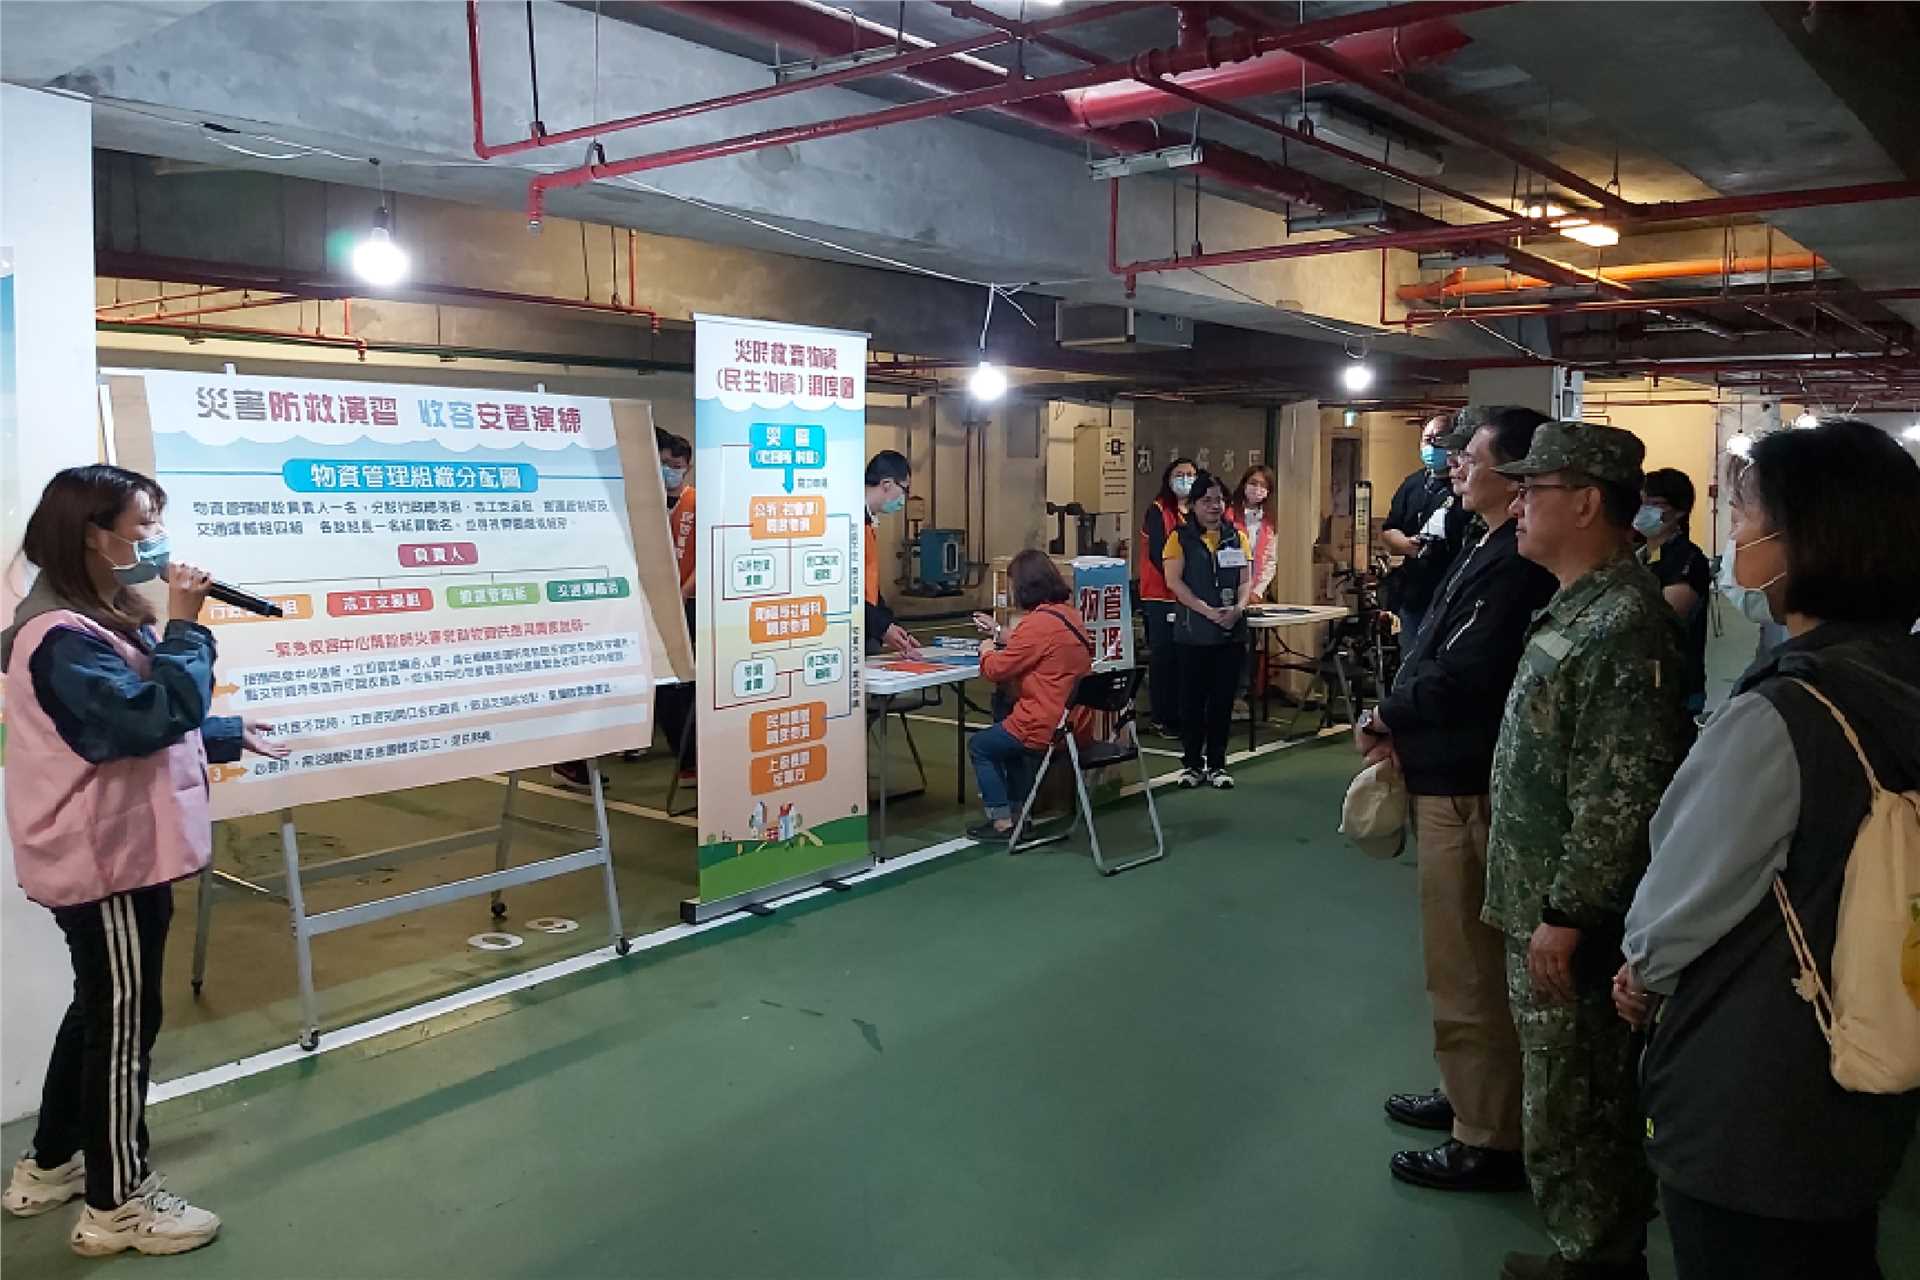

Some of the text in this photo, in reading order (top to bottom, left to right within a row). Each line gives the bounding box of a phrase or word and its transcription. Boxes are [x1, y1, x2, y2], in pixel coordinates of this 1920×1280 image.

[195, 386, 582, 433] 災害防救演習 收容安置演練
[311, 463, 522, 489] 物資管理組織分配圖
